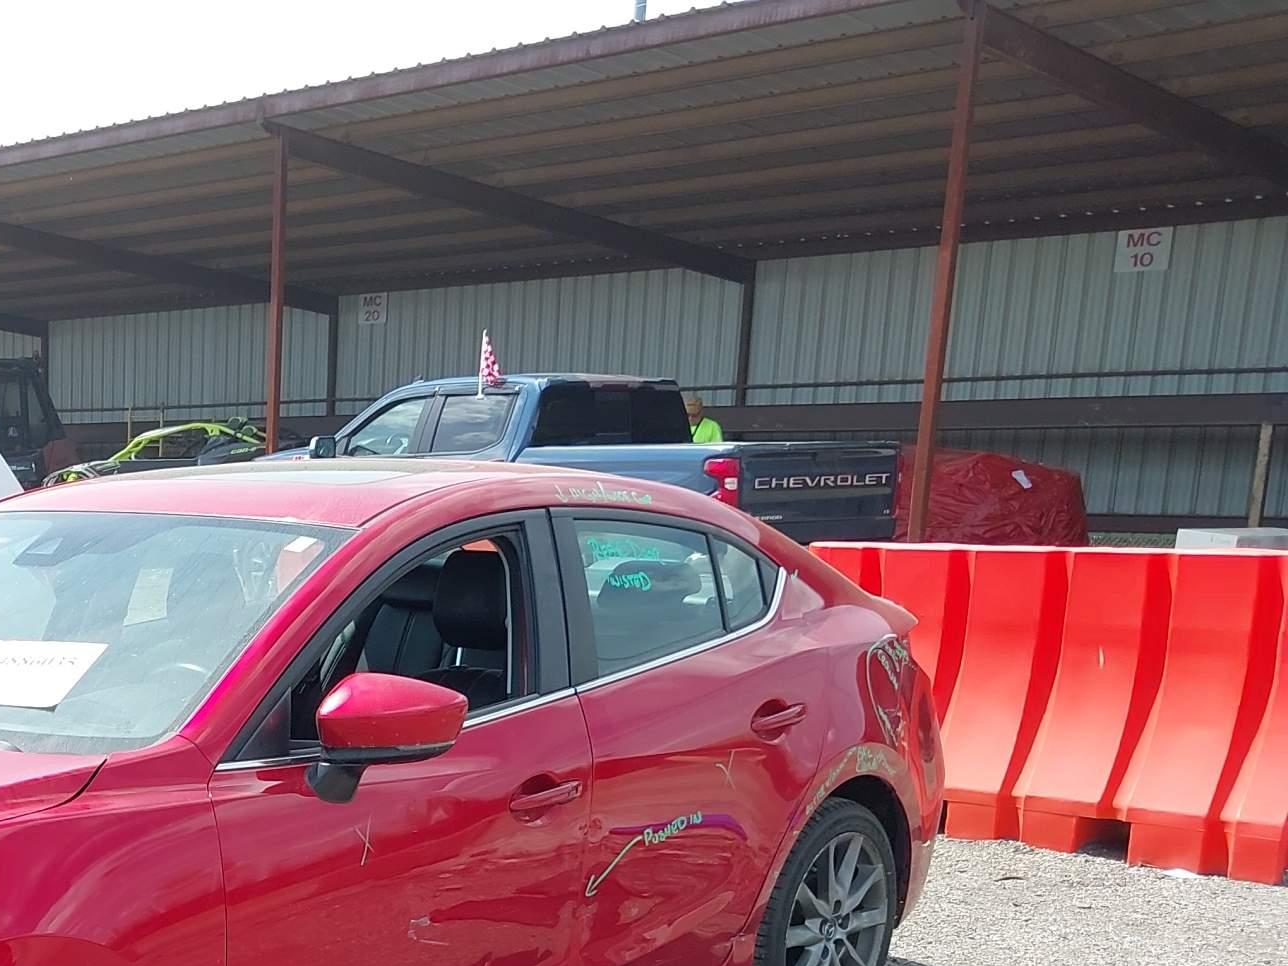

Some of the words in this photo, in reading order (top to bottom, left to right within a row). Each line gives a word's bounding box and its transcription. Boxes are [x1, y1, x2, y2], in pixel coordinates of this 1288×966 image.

[1126, 231, 1162, 249] MC
[1130, 252, 1154, 268] 10
[362, 295, 382, 307] MC
[364, 309, 380, 322] 20
[754, 472, 891, 490] CHEVROLET
